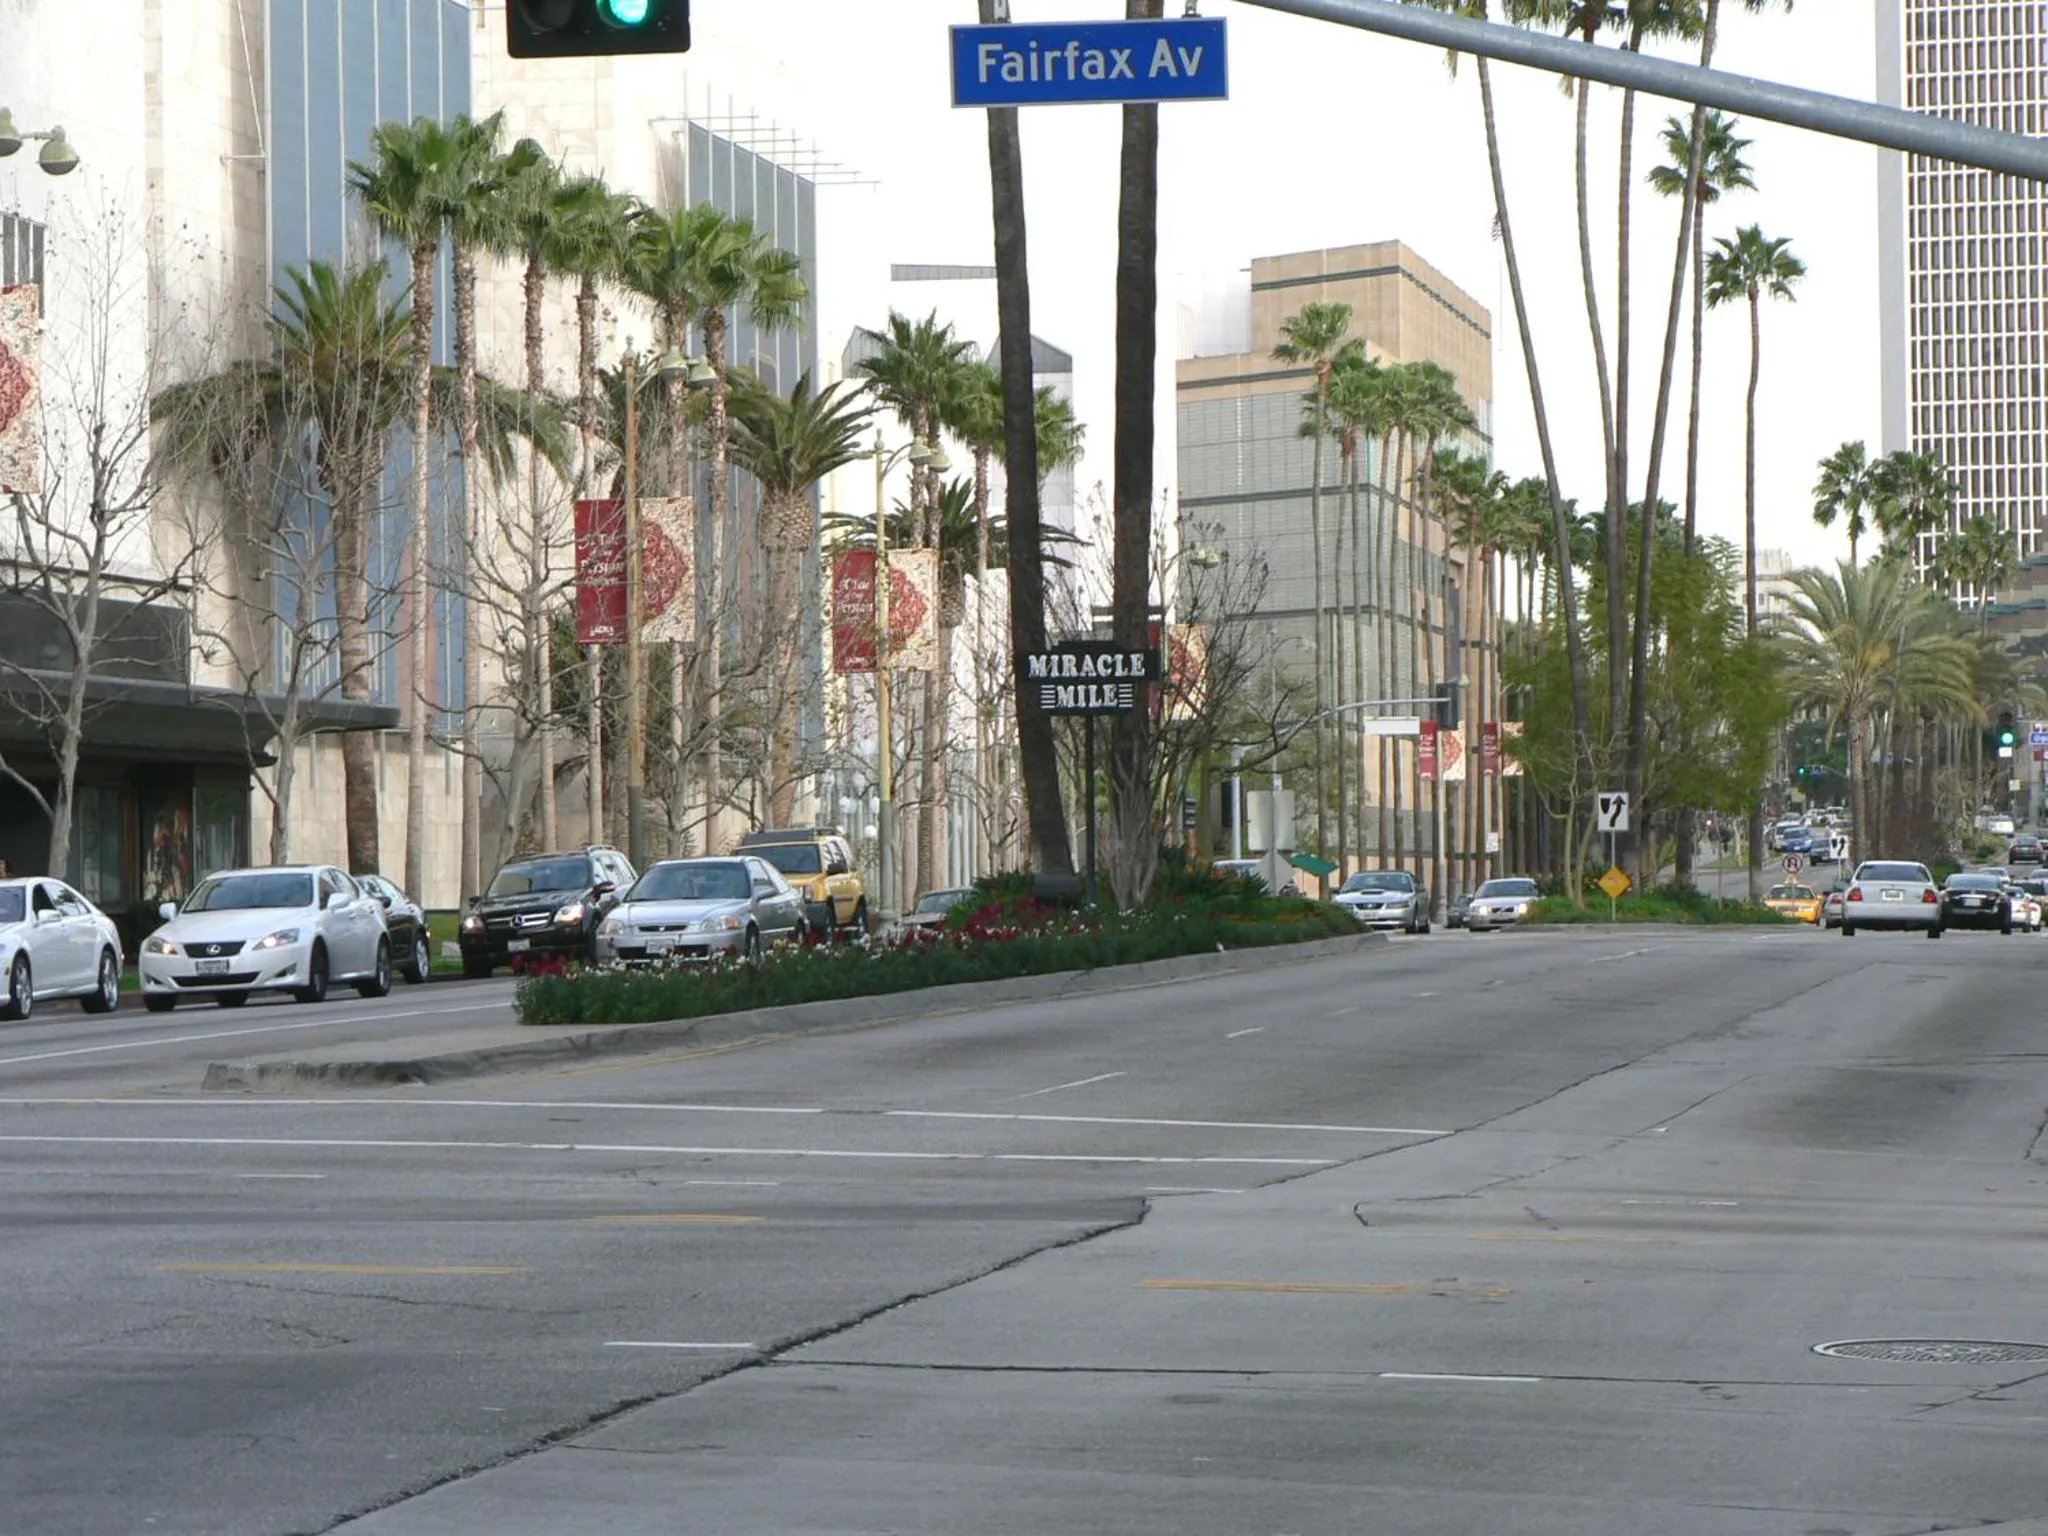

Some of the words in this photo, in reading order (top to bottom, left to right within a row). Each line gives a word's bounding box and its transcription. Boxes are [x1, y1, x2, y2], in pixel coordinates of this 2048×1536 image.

[977, 40, 1134, 83] Fairfax
[1148, 38, 1203, 78] Av
[1028, 653, 1145, 678] MIRACLE
[1056, 684, 1118, 708] MILE
